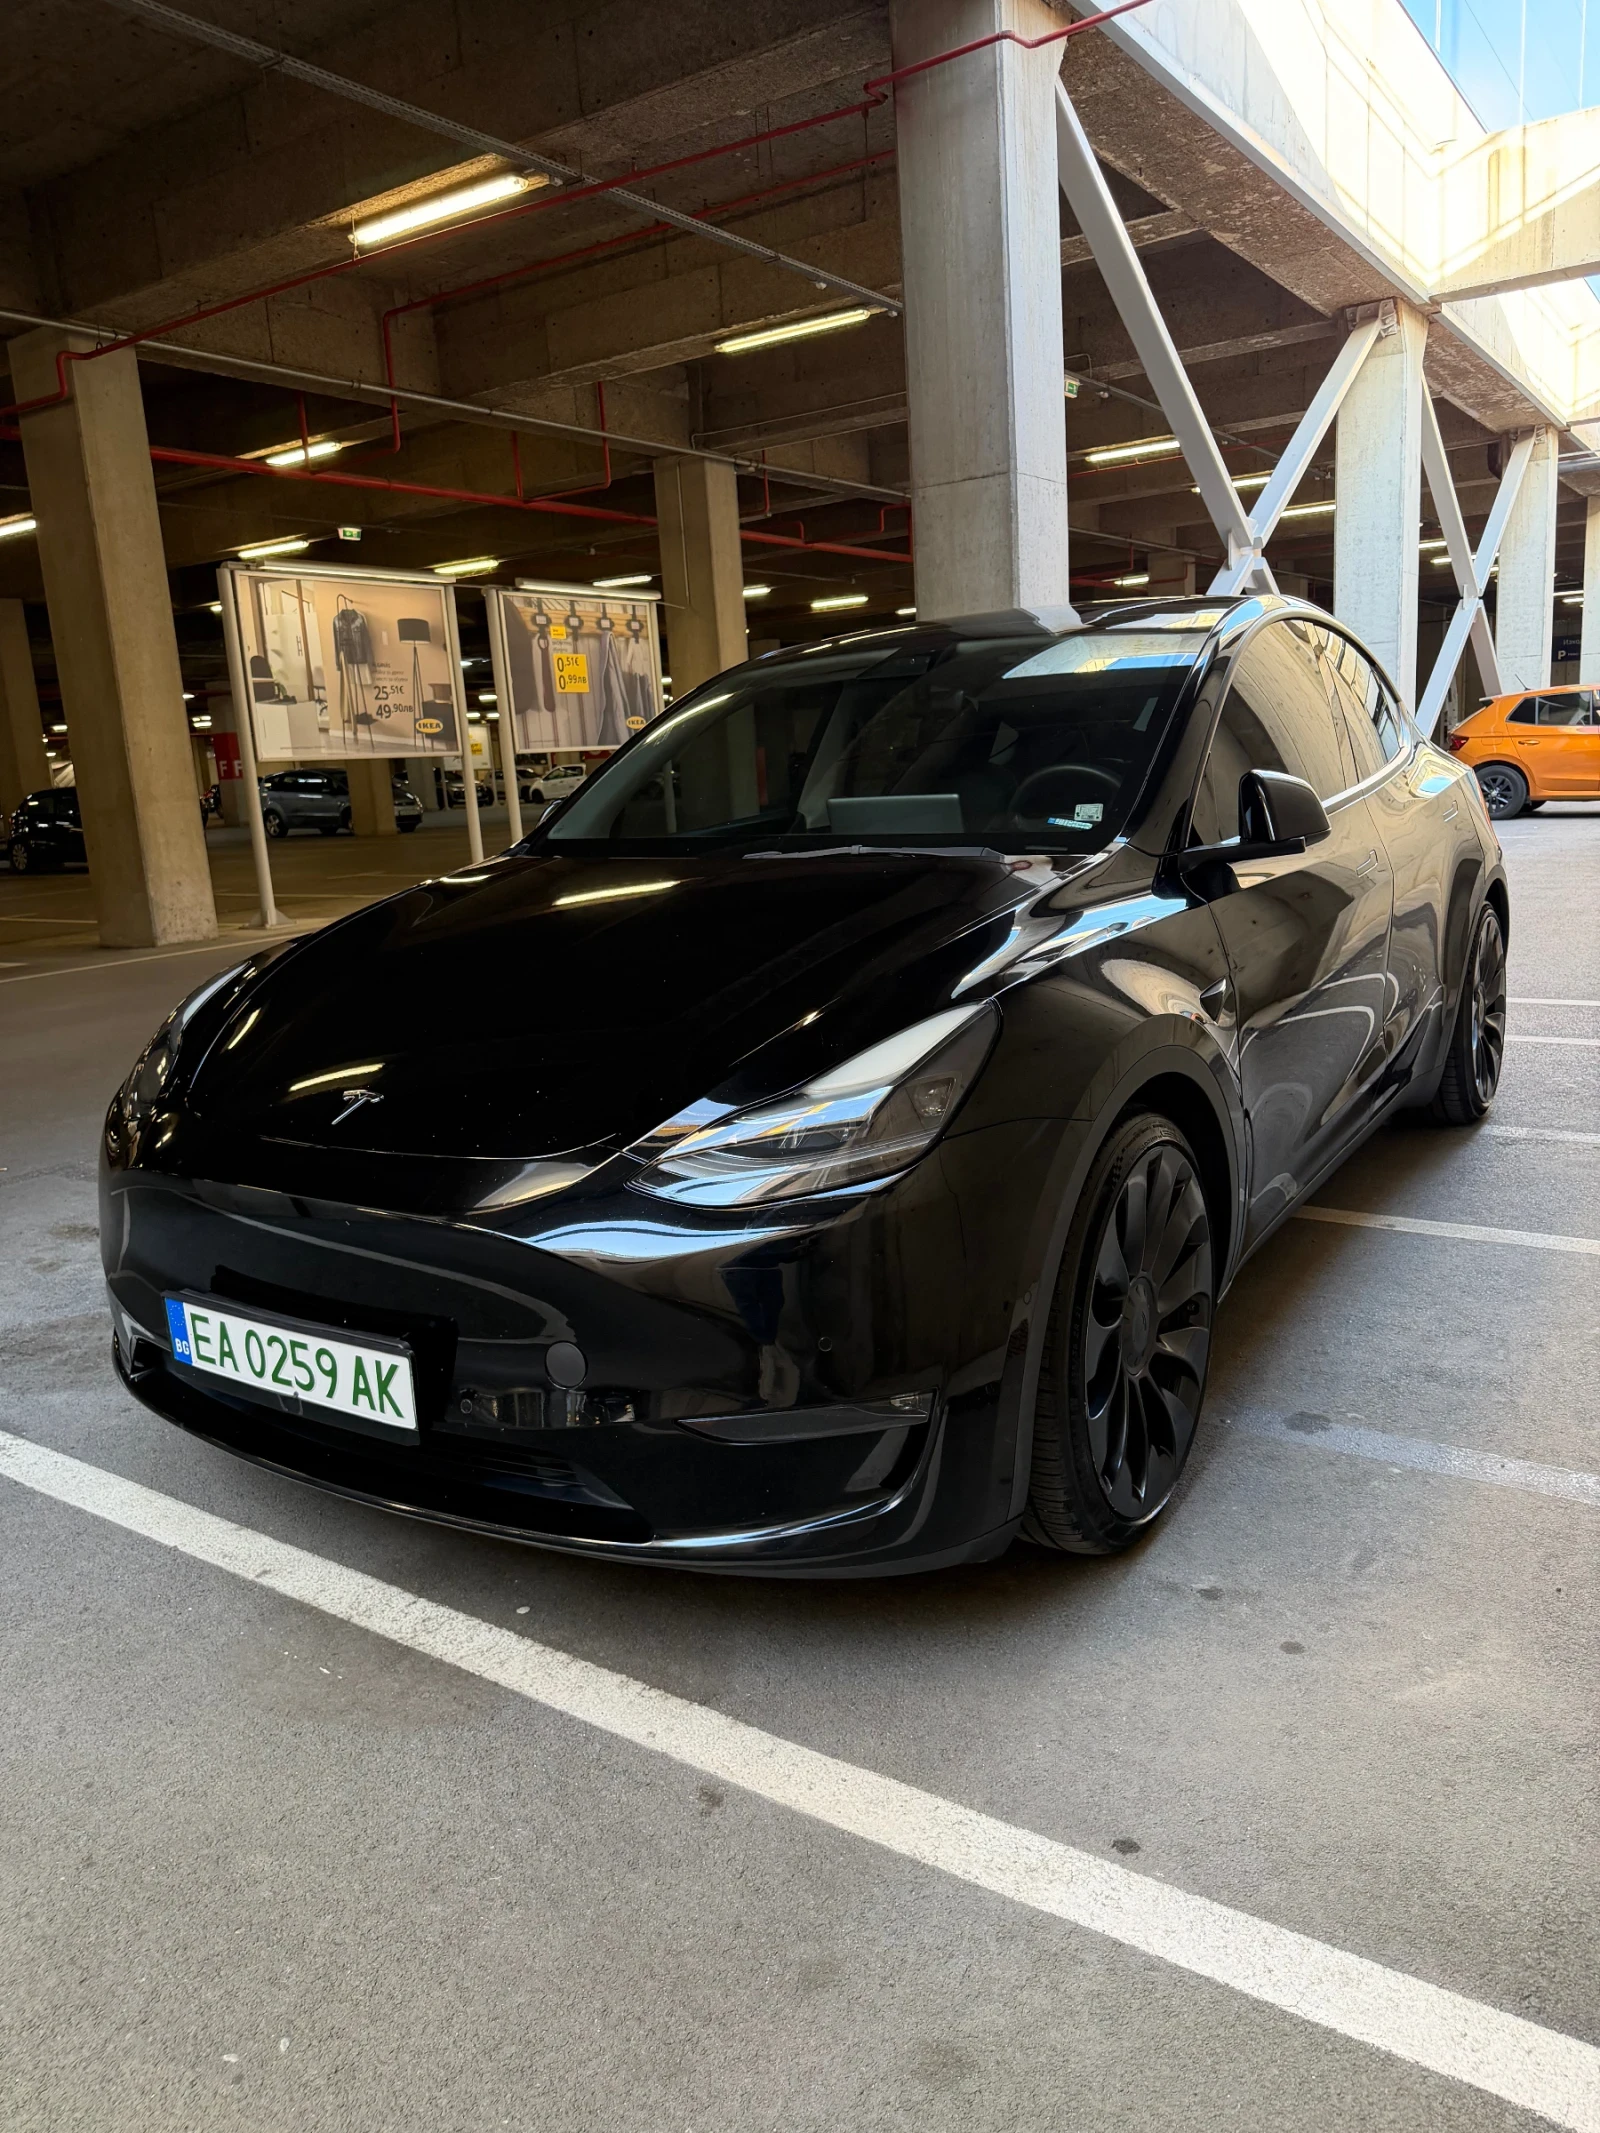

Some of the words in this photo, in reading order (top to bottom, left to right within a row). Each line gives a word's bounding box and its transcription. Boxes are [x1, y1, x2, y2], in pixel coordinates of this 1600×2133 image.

[219, 760, 228, 777] F
[175, 1337, 190, 1356] BG
[190, 1312, 240, 1373] EA
[244, 1329, 338, 1399] 0259
[352, 1355, 405, 1419] AK
